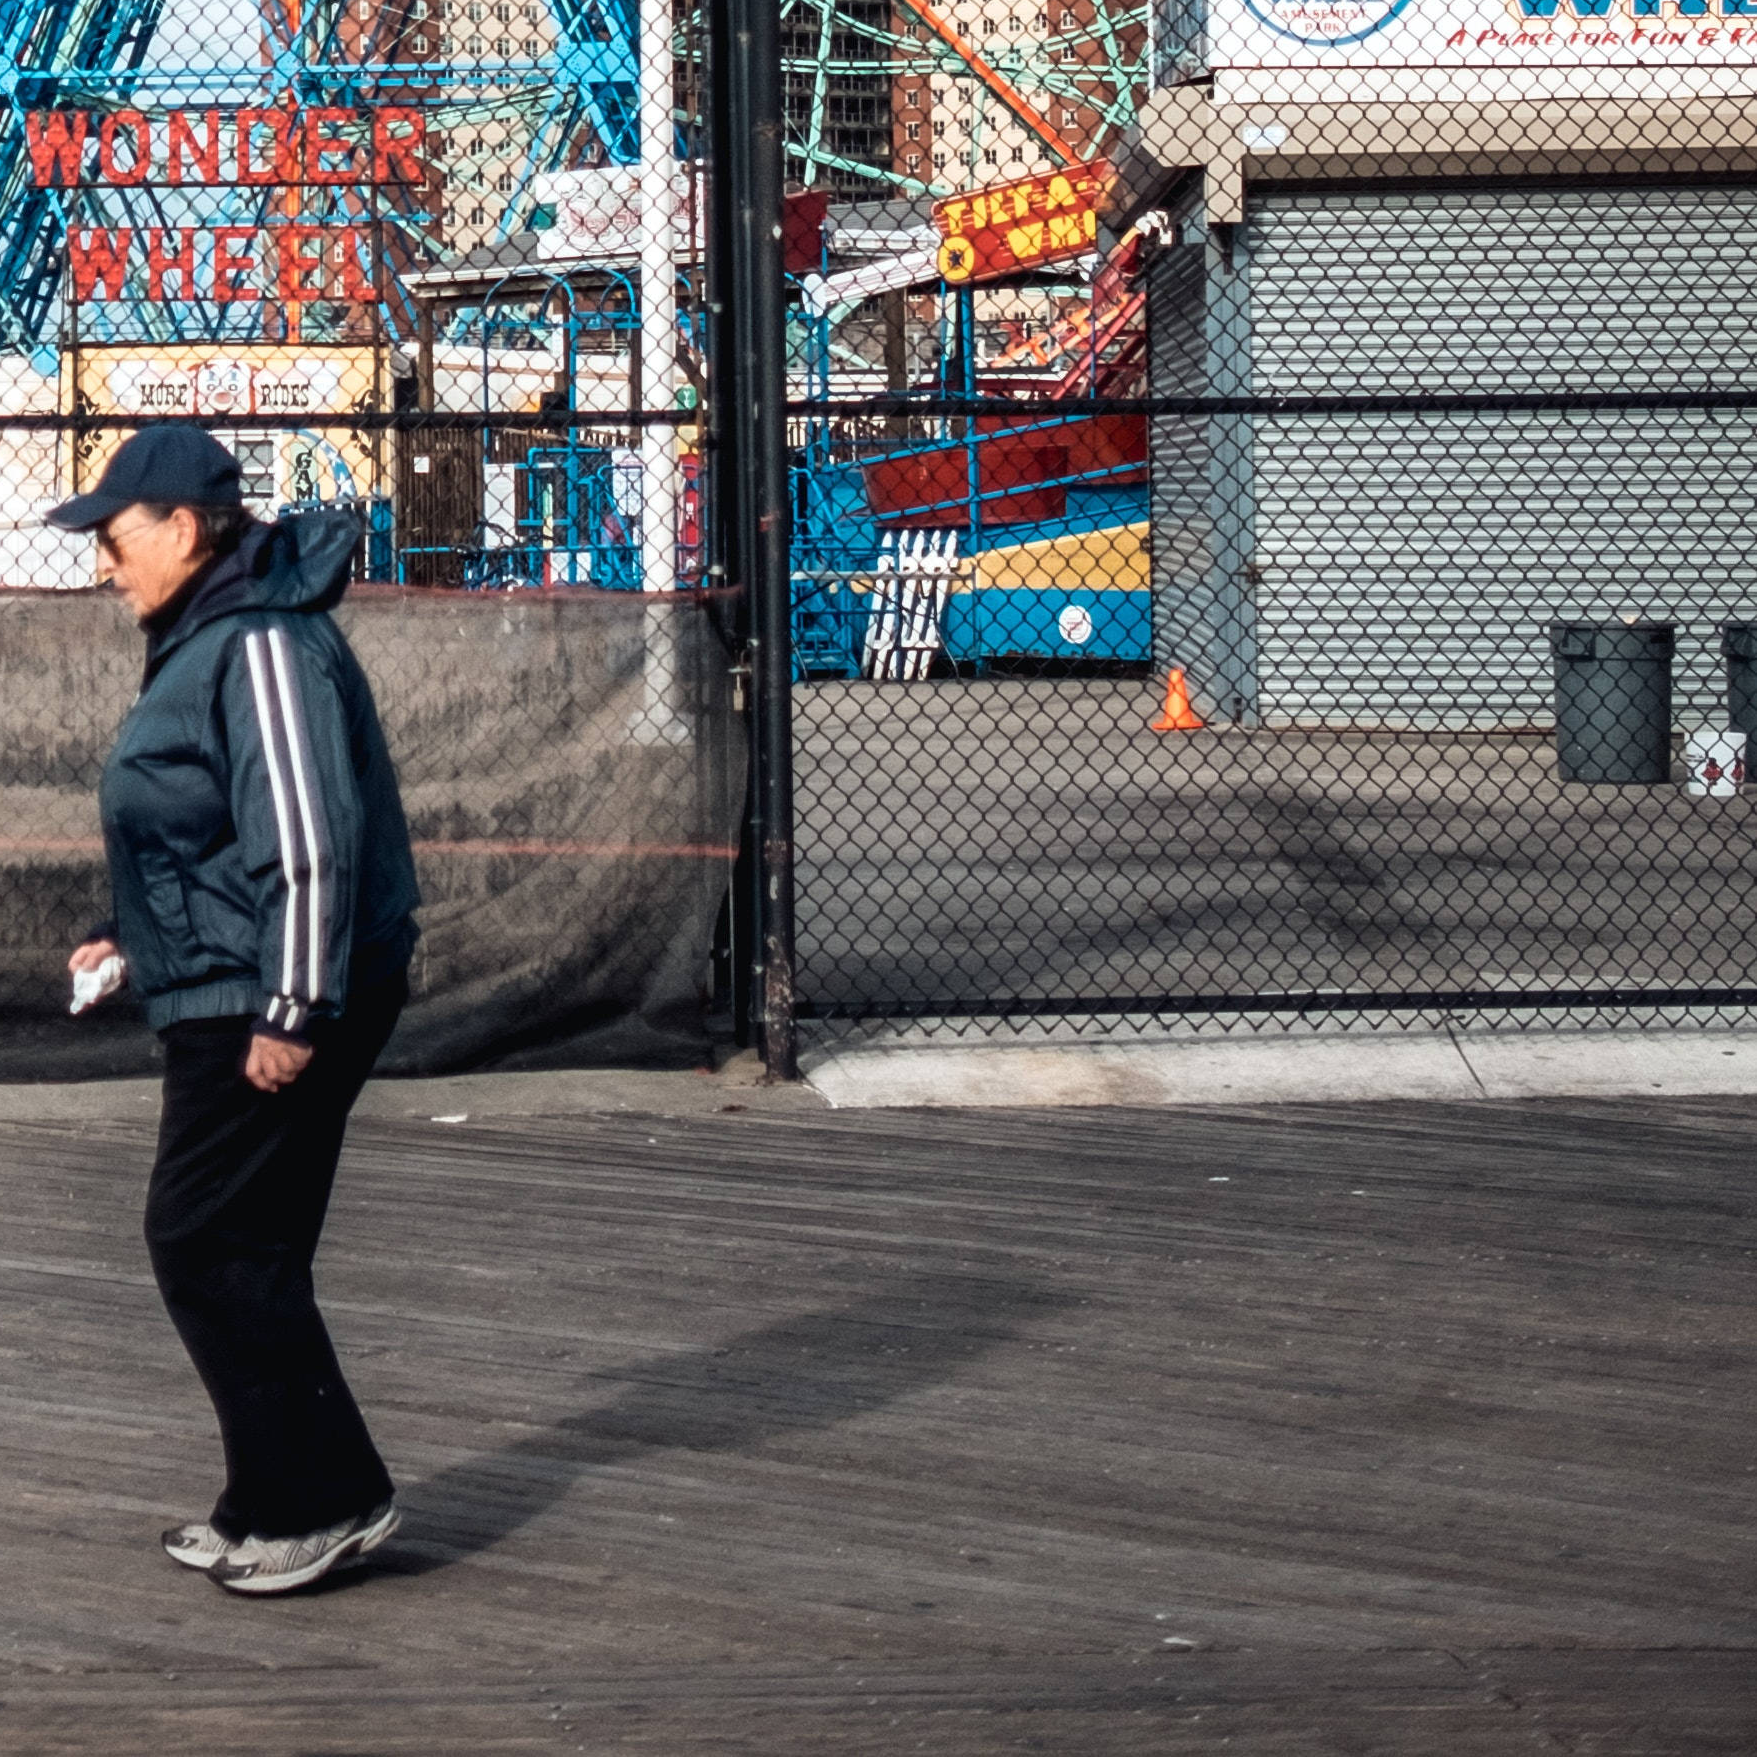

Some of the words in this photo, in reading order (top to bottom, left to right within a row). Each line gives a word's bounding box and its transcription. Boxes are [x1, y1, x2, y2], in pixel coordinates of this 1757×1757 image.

[1446, 28, 1466, 47] A
[1696, 26, 1720, 47] &
[26, 105, 426, 187] WONDER
[66, 224, 377, 302] WHEEL
[140, 384, 188, 406] MORE
[260, 384, 311, 406] RIDES
